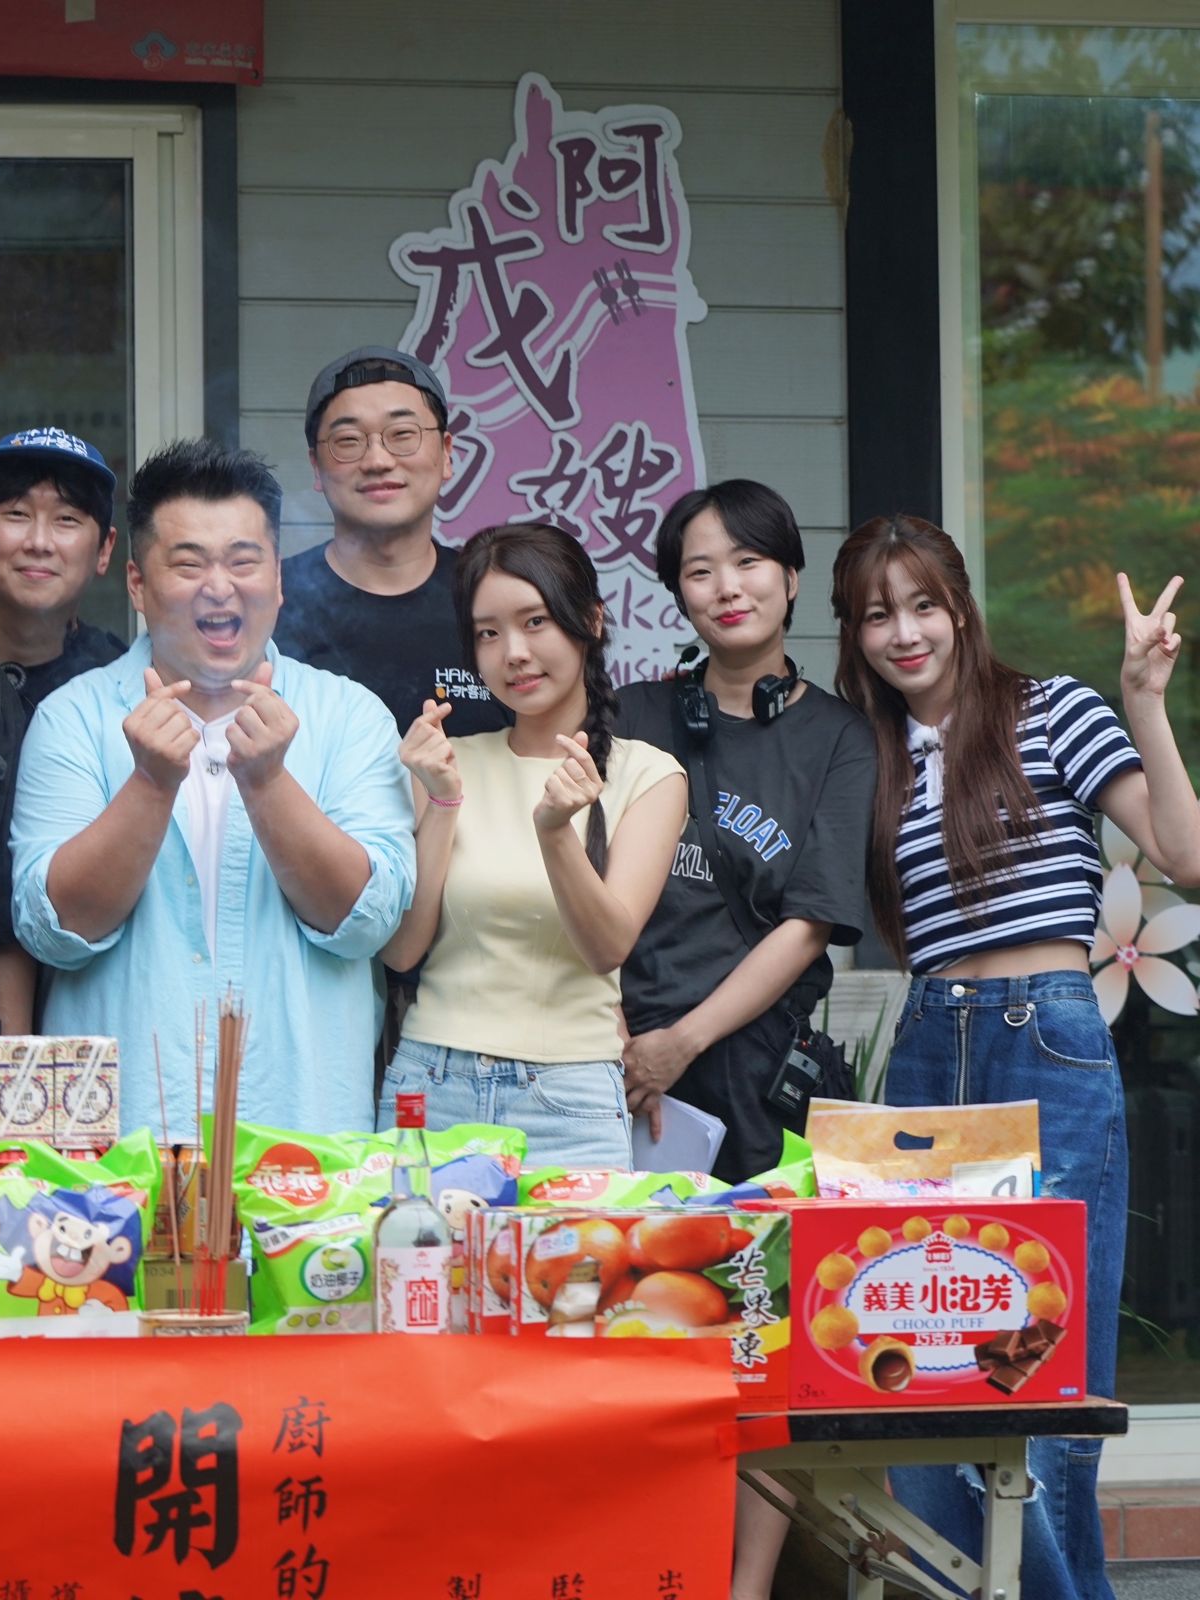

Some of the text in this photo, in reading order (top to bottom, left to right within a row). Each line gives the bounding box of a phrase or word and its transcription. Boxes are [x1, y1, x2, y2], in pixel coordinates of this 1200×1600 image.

[728, 1246, 780, 1368] 芒果凍
[863, 1273, 1013, 1314] 義美 小泡芙
[892, 1317, 985, 1330] CHOCO PUFF
[915, 1333, 963, 1346] 巧克力
[113, 1402, 243, 1600] 開
[272, 1395, 332, 1600] 廚師的
[657, 1570, 684, 1600] 出
